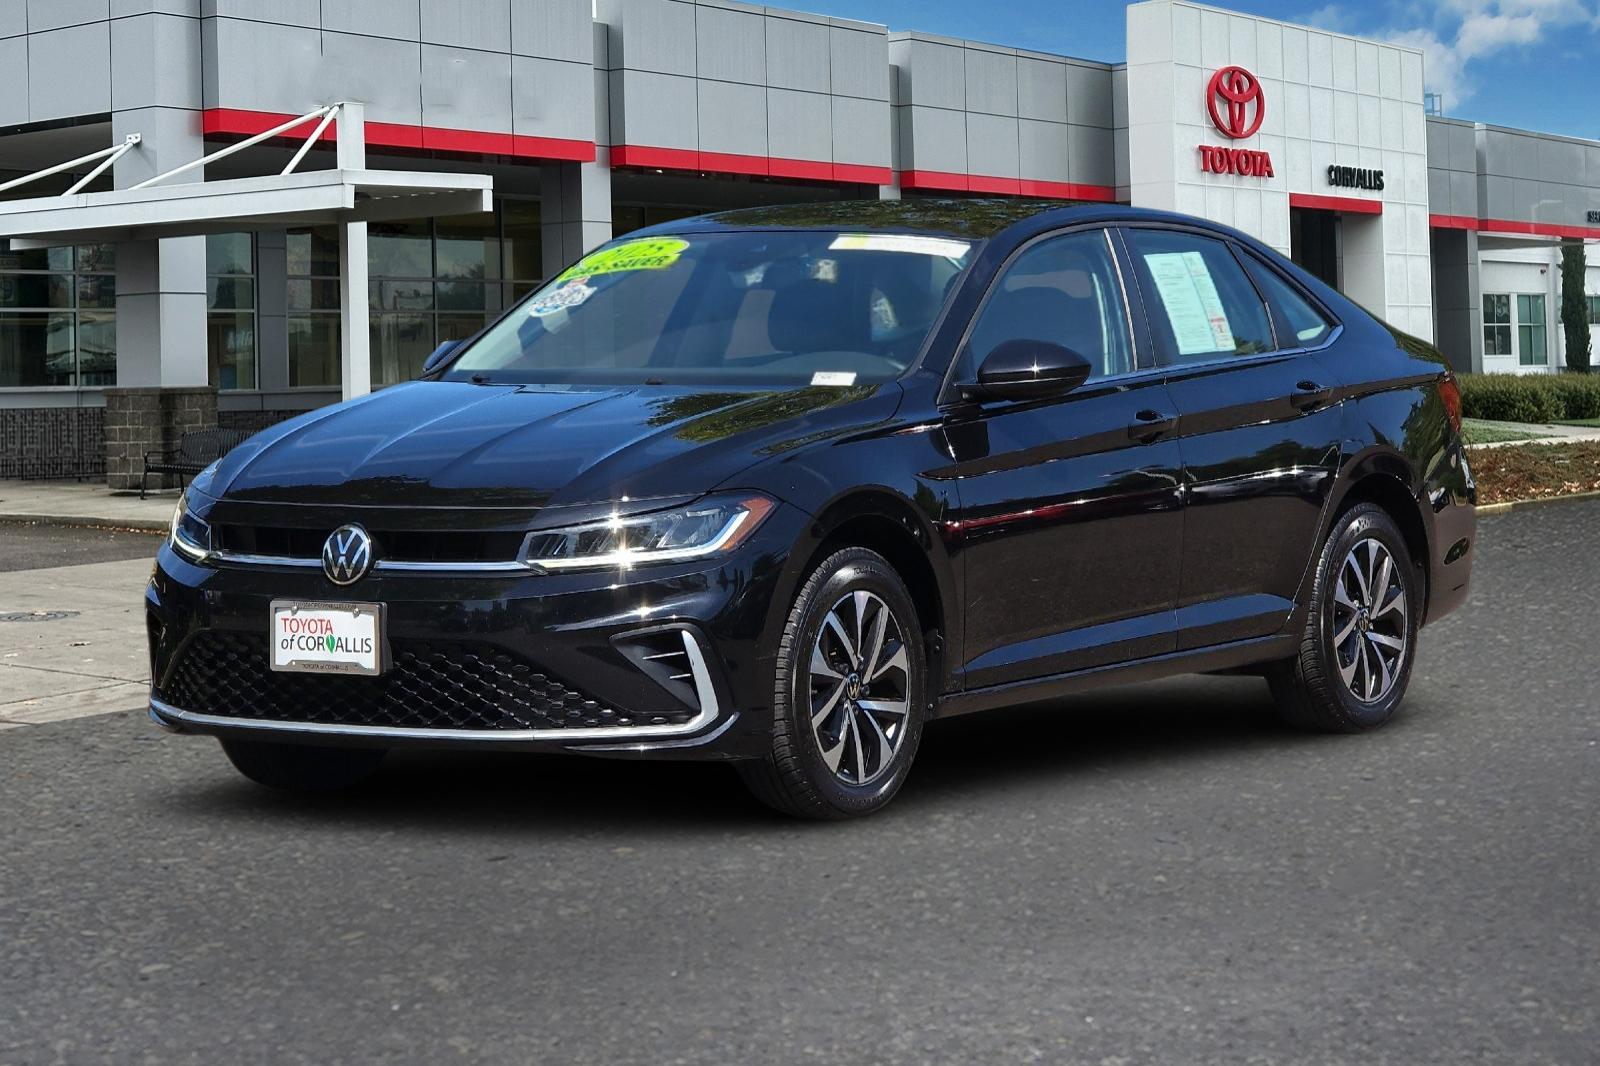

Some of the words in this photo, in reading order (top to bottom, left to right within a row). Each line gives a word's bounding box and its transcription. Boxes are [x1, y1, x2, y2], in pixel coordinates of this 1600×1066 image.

[1199, 144, 1274, 178] TOYOTA
[1328, 164, 1384, 191] CORVALLIS
[281, 617, 334, 635] TOYOTA
[281, 634, 296, 651] of
